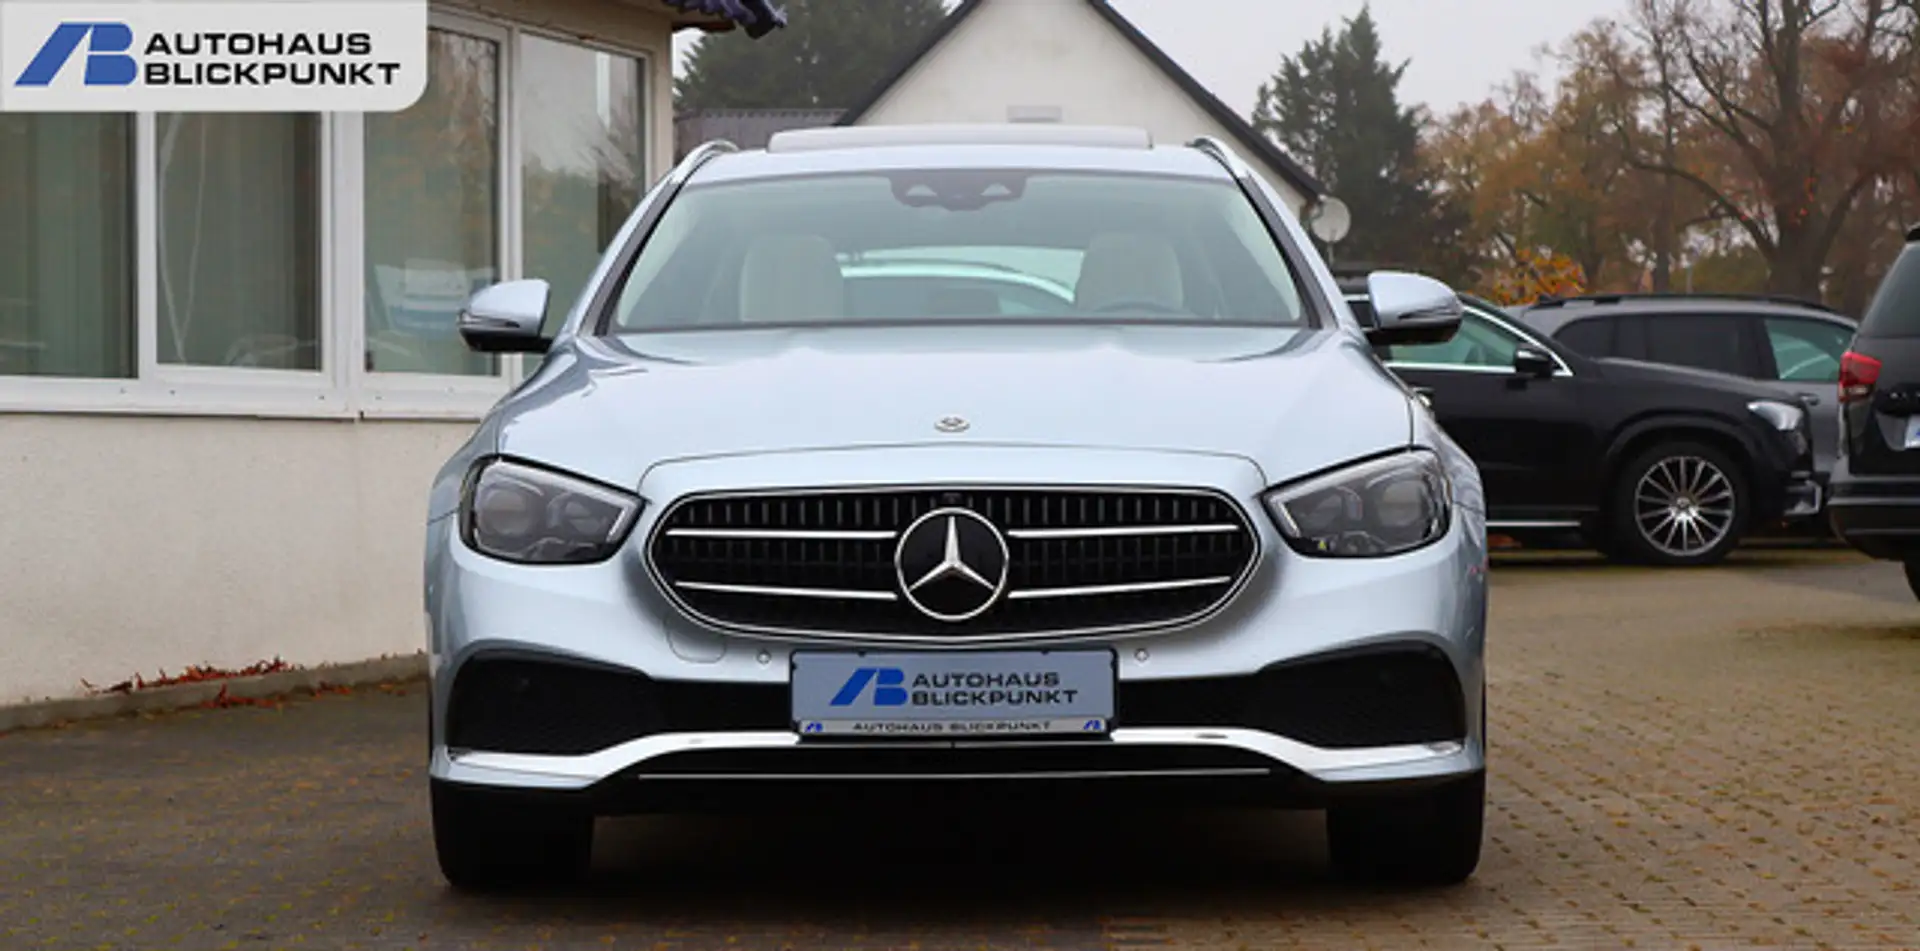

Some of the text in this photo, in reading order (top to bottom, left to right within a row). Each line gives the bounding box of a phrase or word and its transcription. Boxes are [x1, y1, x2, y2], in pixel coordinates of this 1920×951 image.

[912, 672, 1060, 688] AUTOHAUS
[912, 689, 1078, 706] BLICKPUNKT
[853, 721, 1051, 732] AUTOHAUS BLICKPUNKT
